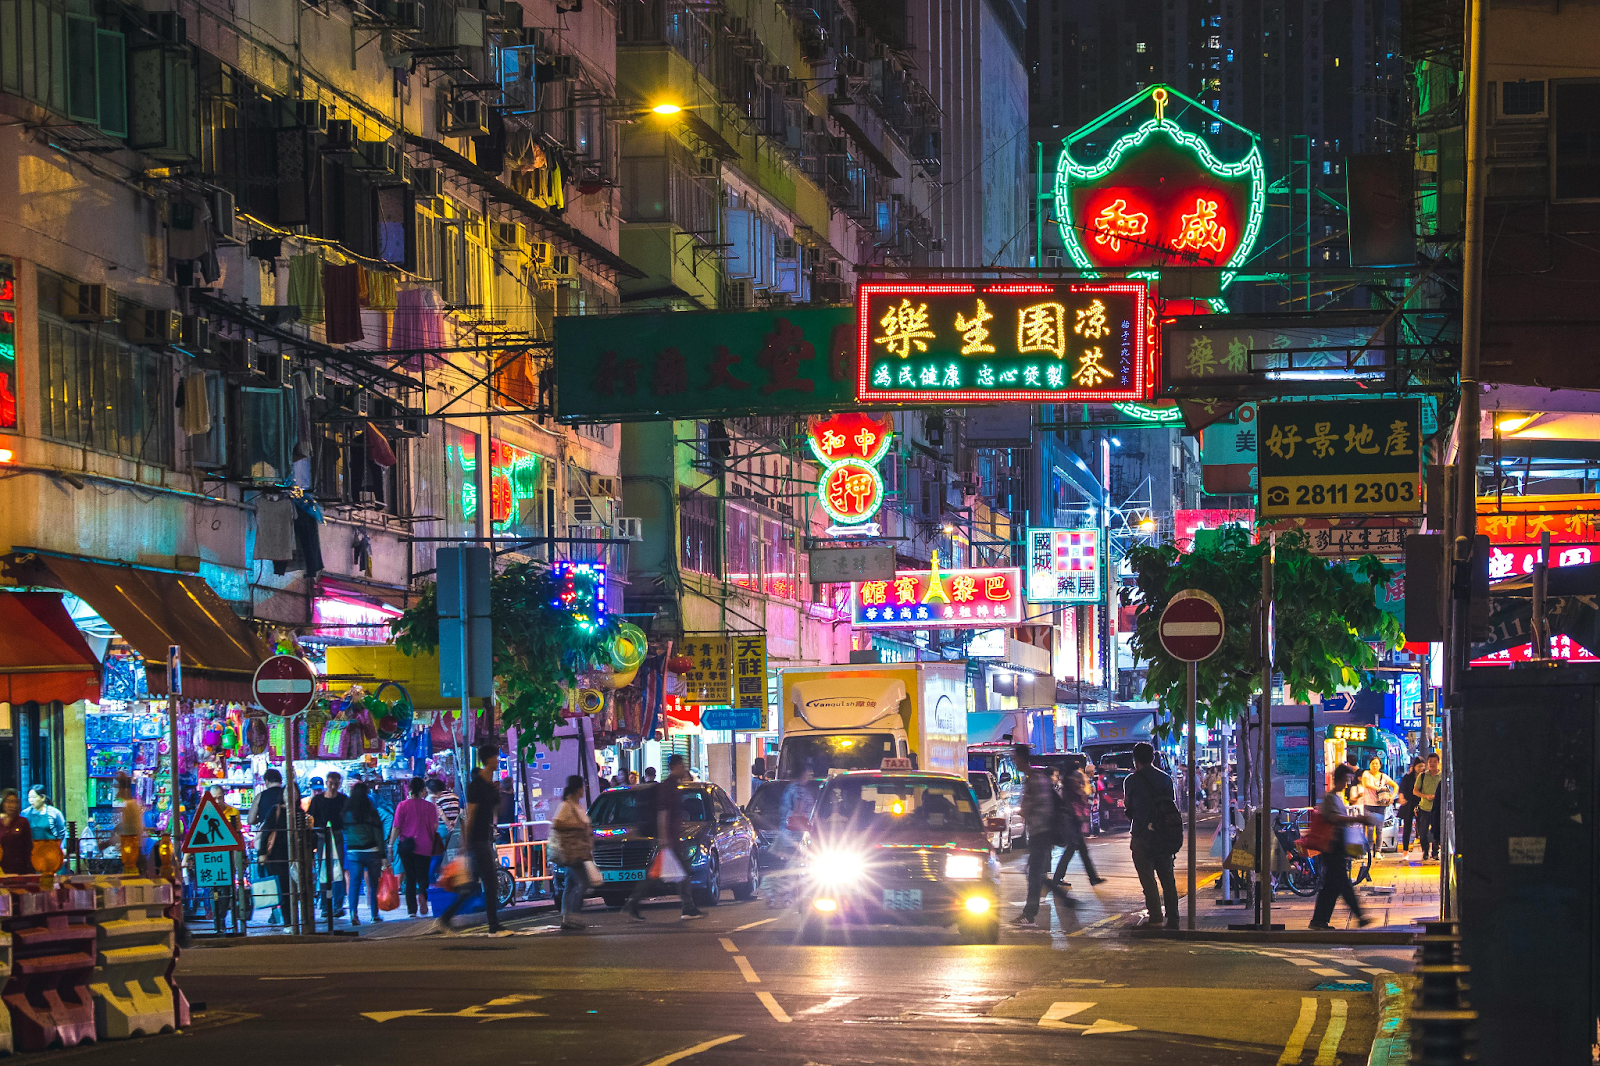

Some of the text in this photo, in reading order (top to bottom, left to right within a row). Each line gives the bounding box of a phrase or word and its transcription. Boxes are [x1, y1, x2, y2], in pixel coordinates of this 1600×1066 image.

[874, 298, 1066, 359] 樂生園
[1265, 419, 1414, 460] 好景地產
[829, 469, 873, 514] 押
[1296, 481, 1414, 505] 2811 2303
[1100, 727, 1128, 738] LST
[884, 759, 910, 767] TAXI
[203, 853, 223, 864] End
[200, 867, 229, 883] 終止
[618, 871, 643, 880] 5268
